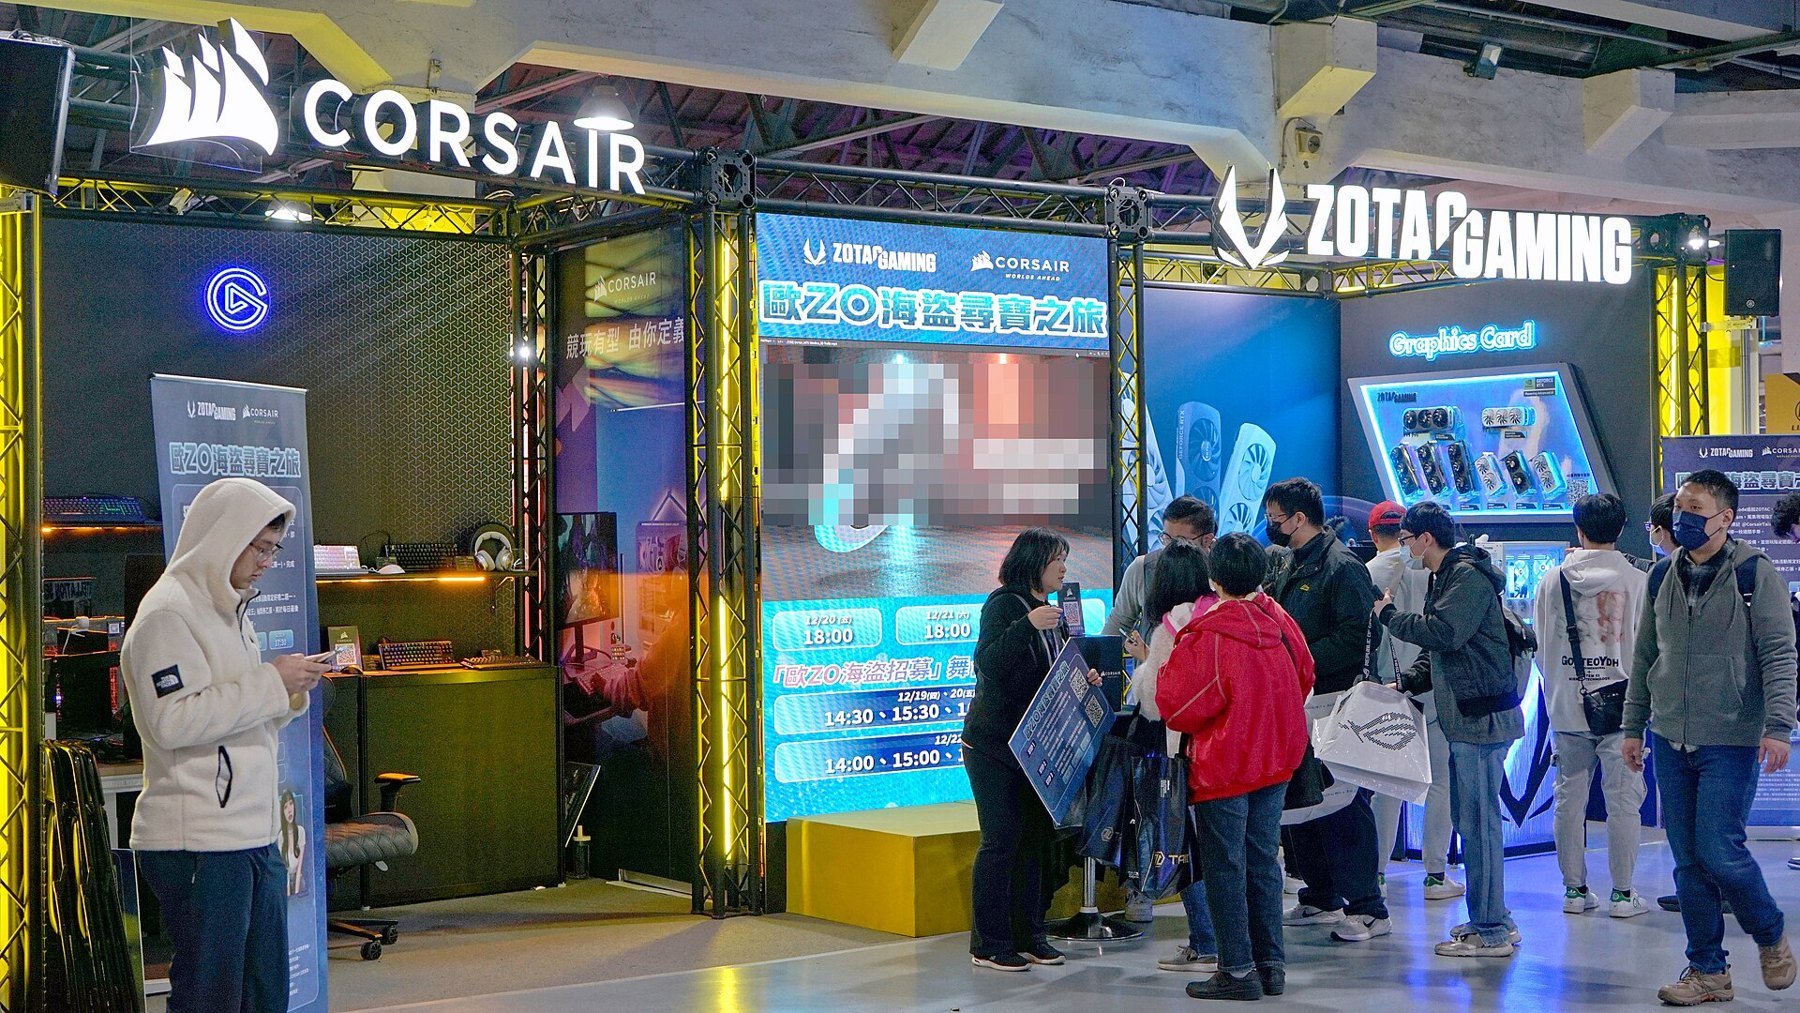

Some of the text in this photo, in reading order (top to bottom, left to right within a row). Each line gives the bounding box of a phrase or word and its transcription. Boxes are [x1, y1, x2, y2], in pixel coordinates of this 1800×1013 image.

[304, 78, 646, 195] CORSAIR
[1307, 183, 1632, 285] ZOTAC GAMING
[832, 242, 937, 273] ZOTAC GAMING
[995, 256, 1070, 273] CORSAIR
[608, 271, 656, 293] CORSAIR
[758, 279, 1108, 338] 歐ZO海盜尋寶之旅
[566, 316, 684, 359] 競玩有型 由你定義
[1389, 320, 1535, 360] Graphics Card
[197, 402, 237, 421] ZOTAC GAMING
[250, 408, 279, 418] CORSAIR
[169, 442, 302, 478] 歐ZO海盜尋寶之旅
[1710, 448, 1754, 458] ZOTAC GAMING
[804, 616, 836, 626] 12/20
[926, 610, 954, 620] 12/21
[803, 628, 854, 646] 18:00
[923, 623, 971, 640] 18:00
